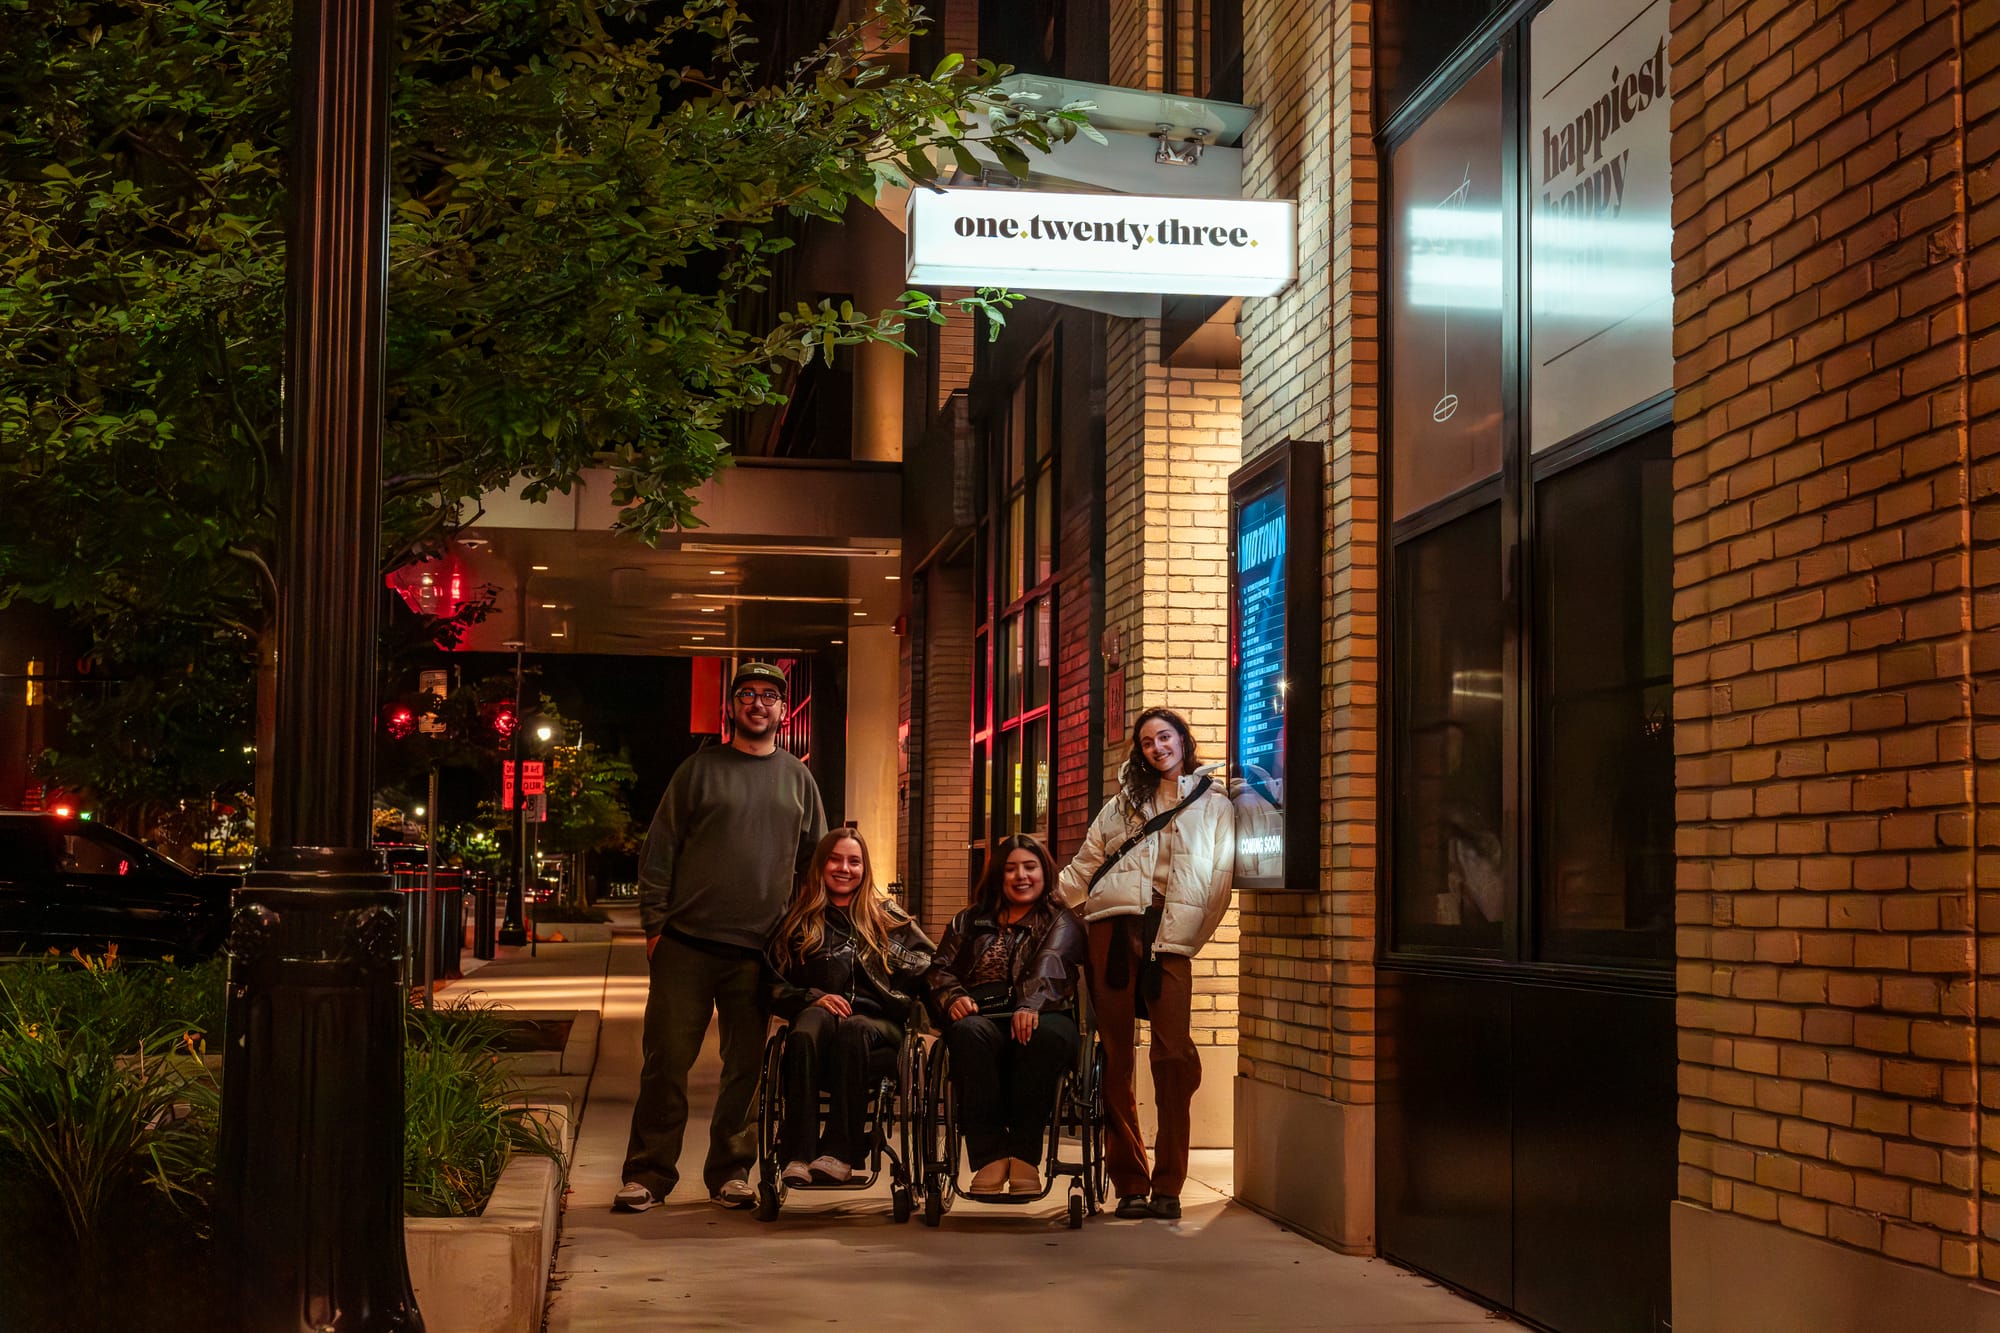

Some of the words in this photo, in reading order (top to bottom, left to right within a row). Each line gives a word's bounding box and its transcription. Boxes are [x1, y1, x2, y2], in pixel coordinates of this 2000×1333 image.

[1542, 34, 1667, 186] happiest
[1543, 148, 1630, 222] happy
[1241, 514, 1286, 573] MIDTOWN
[1241, 836, 1264, 855] COMING
[1264, 834, 1281, 853] SOON
